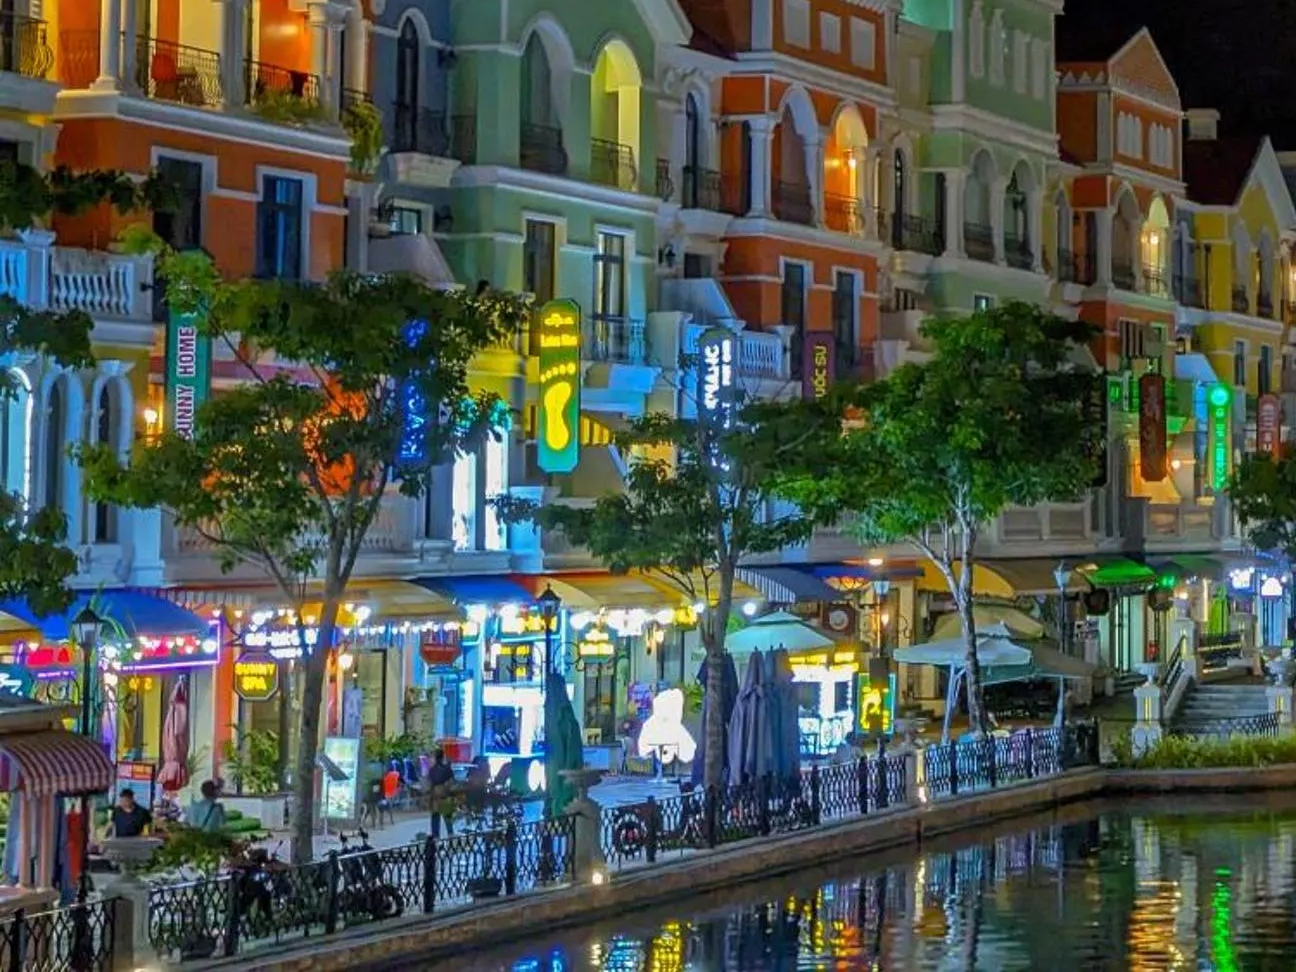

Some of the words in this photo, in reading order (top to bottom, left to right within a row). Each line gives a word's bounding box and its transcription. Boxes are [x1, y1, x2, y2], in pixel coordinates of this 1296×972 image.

[176, 326, 196, 378] HOME
[234, 661, 276, 676] SUNNY
[242, 675, 267, 691] SPA
